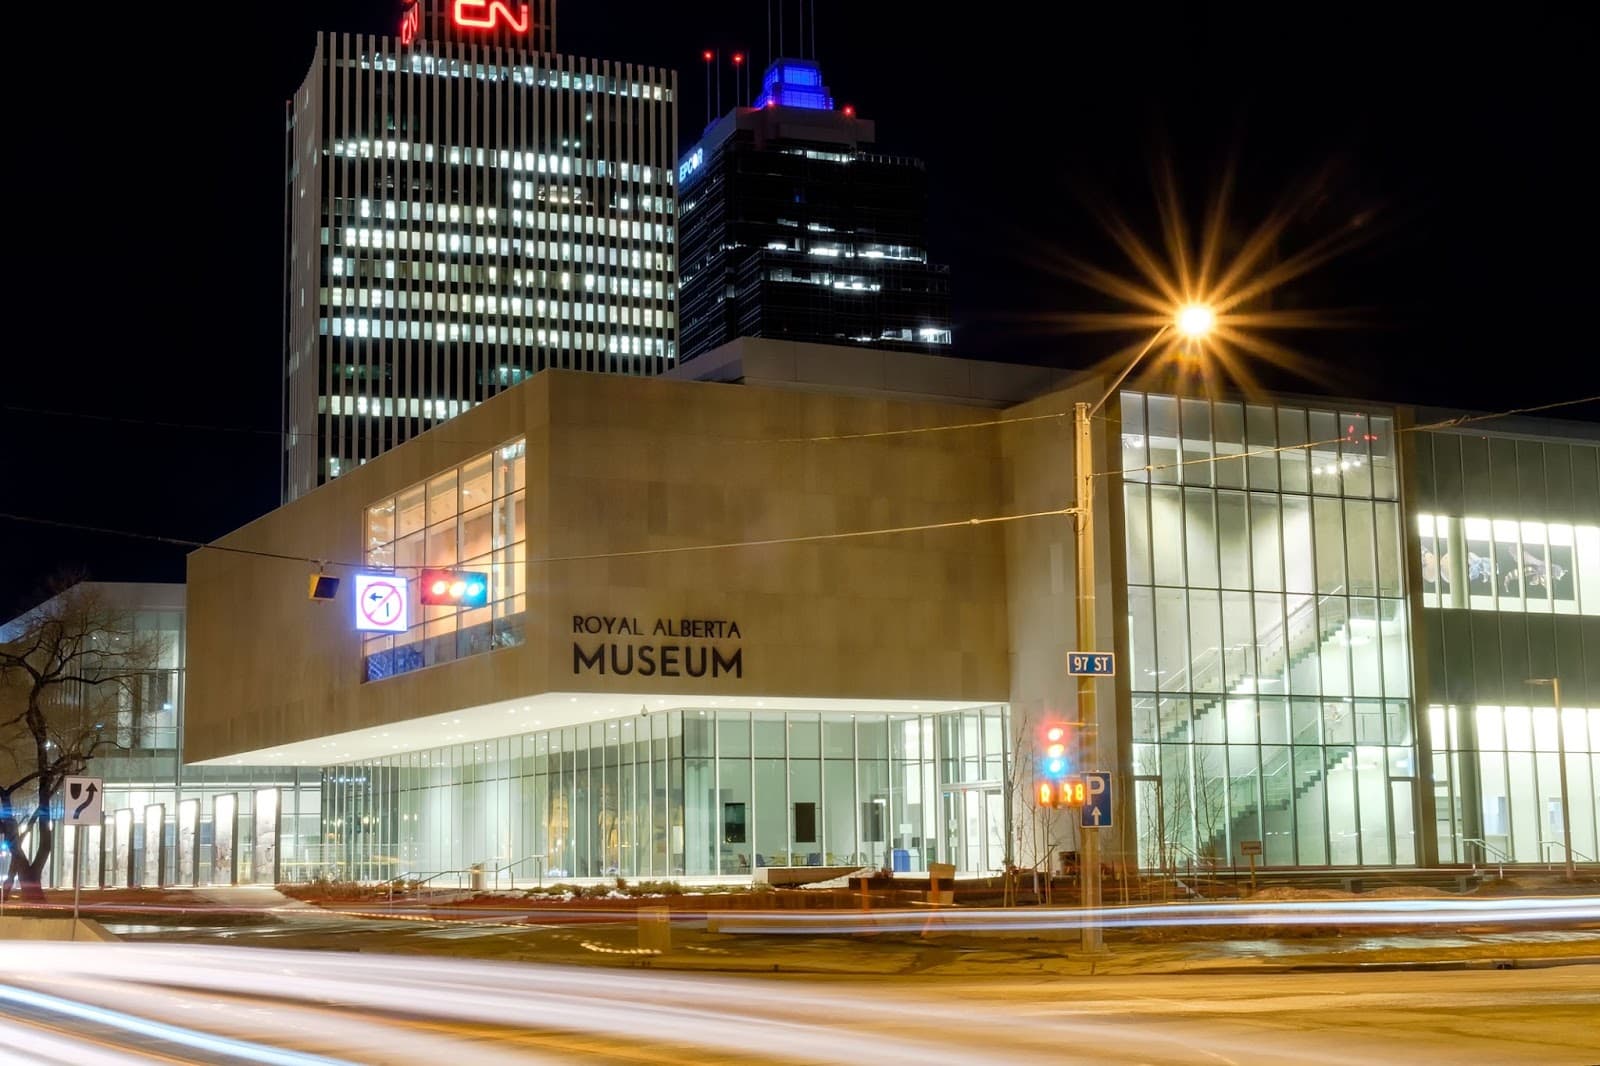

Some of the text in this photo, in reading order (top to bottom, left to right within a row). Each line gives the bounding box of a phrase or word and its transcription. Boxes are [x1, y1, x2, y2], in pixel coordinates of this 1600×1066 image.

[454, 0, 528, 32] CN
[679, 147, 703, 183] EPCOR
[573, 615, 741, 639] ROYAL ALBERTA
[573, 642, 743, 678] MUSEUM
[1074, 656, 1109, 671] 97 ST
[1086, 775, 1105, 805] P
